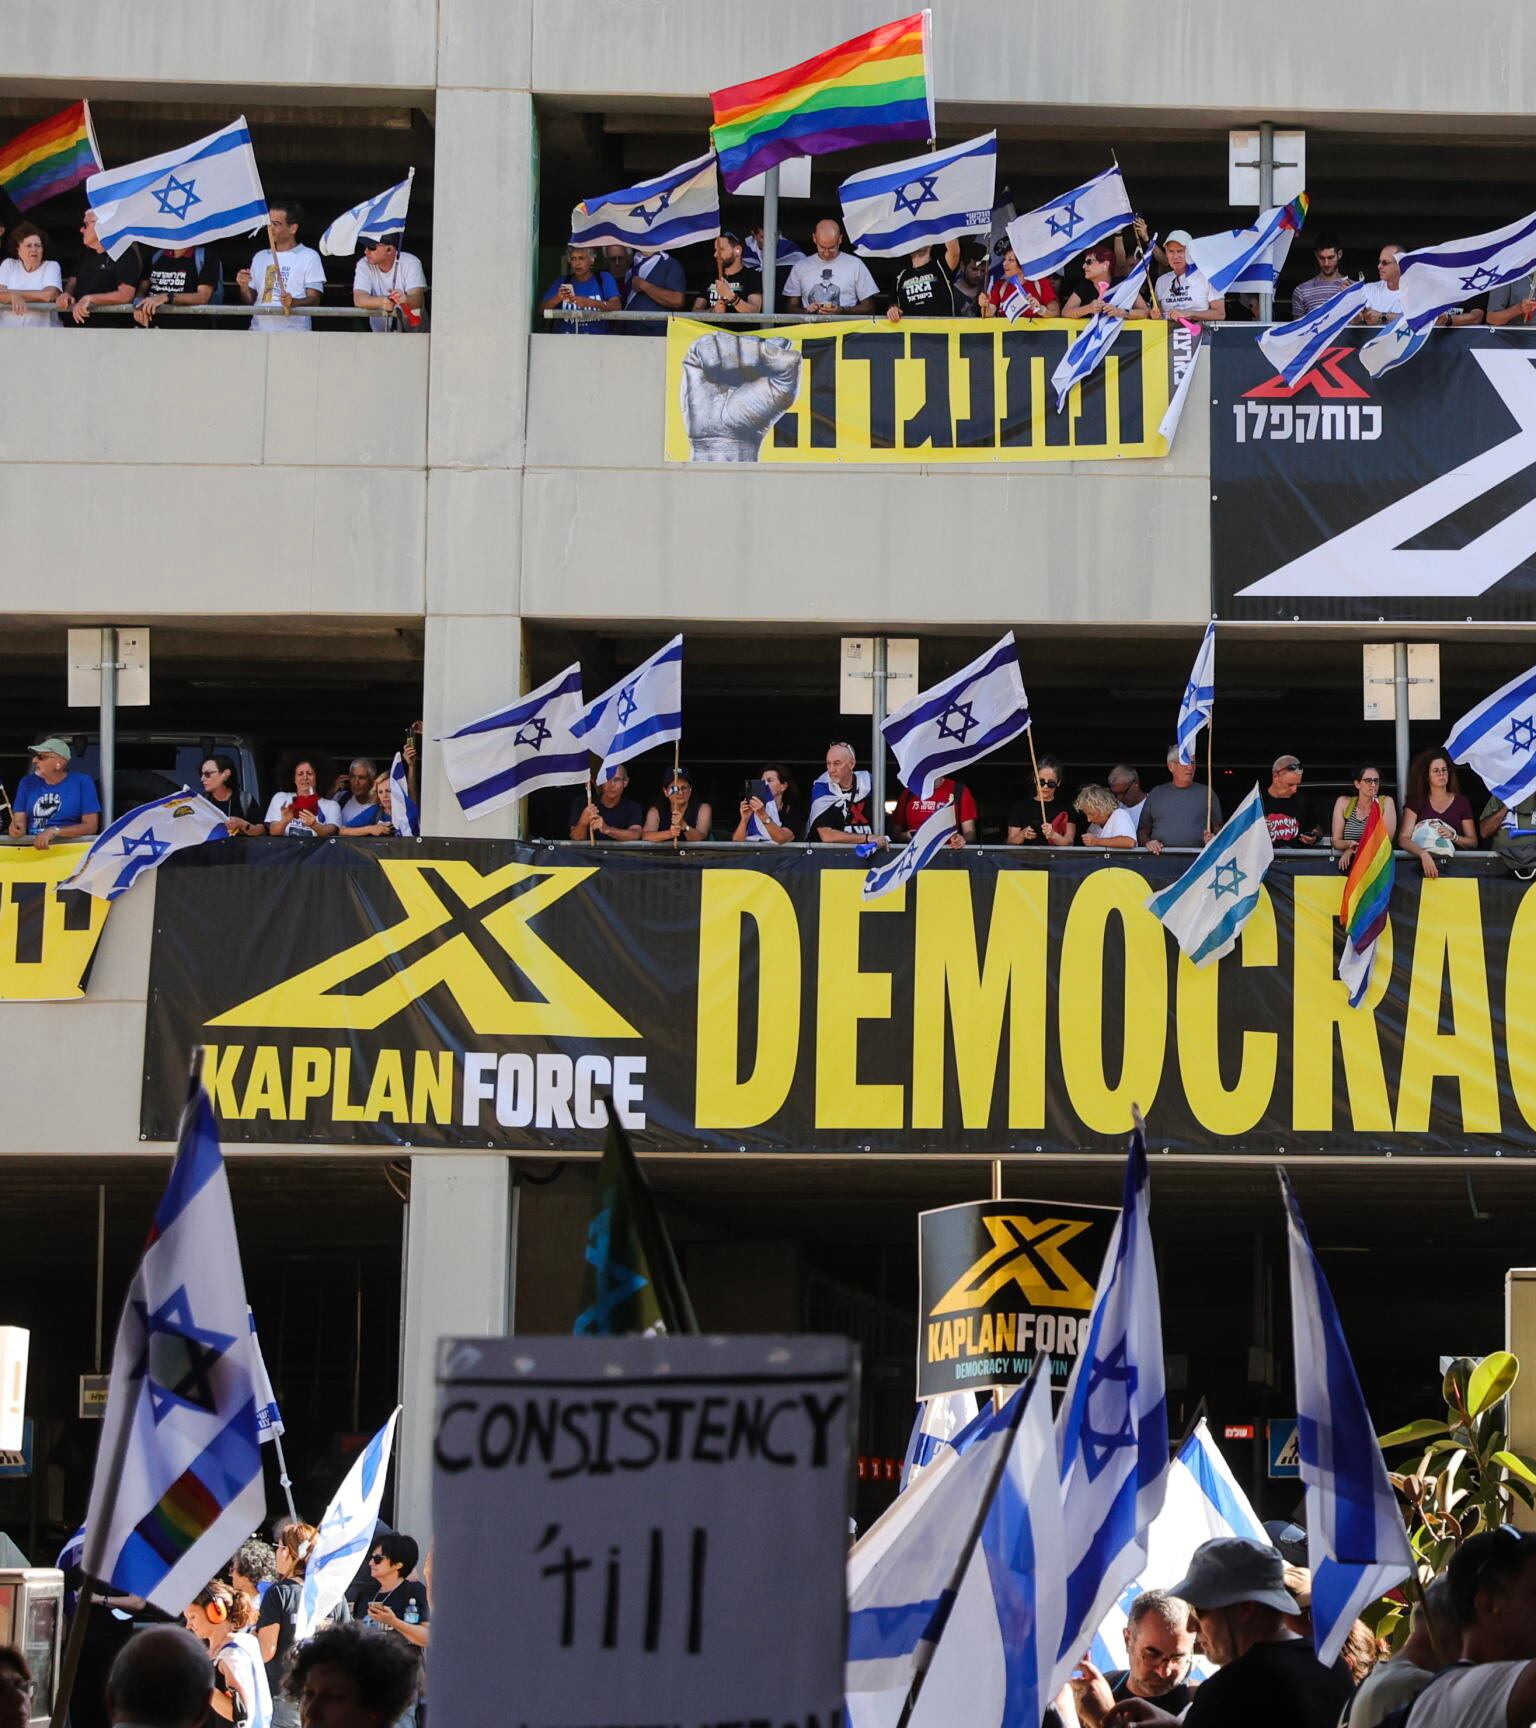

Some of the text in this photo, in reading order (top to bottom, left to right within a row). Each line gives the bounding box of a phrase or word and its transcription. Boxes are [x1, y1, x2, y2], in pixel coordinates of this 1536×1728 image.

[1233, 401, 1383, 443] כוחקפלן
[955, 1357, 1010, 1379] DEMOCRACY
[433, 1392, 847, 1480] CONSISTENCY
[534, 1523, 707, 1654] 'till
